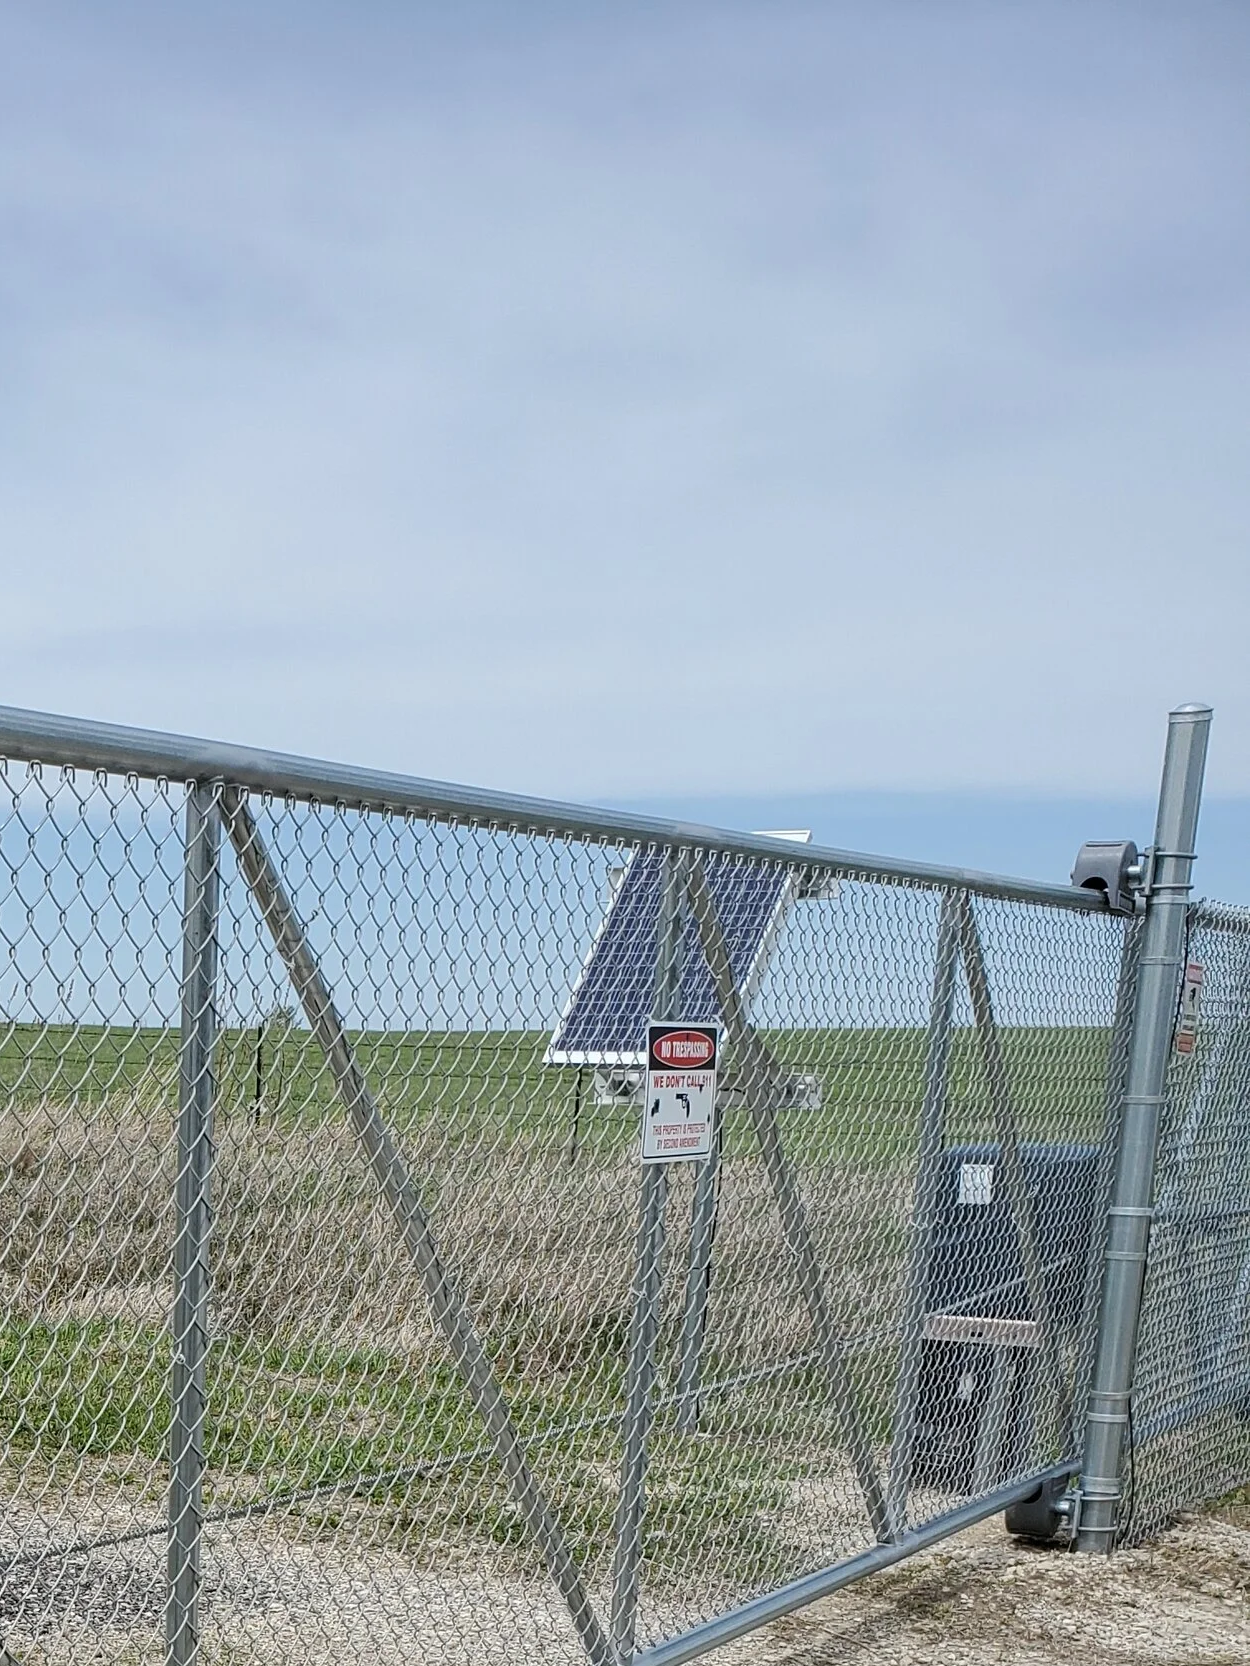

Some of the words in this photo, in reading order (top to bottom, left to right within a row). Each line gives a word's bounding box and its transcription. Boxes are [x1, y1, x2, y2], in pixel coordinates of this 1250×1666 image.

[661, 1041, 671, 1058] NO
[672, 1041, 709, 1058] TRESPASSING
[653, 1075, 664, 1089] WE
[665, 1075, 686, 1089] DON'T
[686, 1074, 700, 1088] CALL
